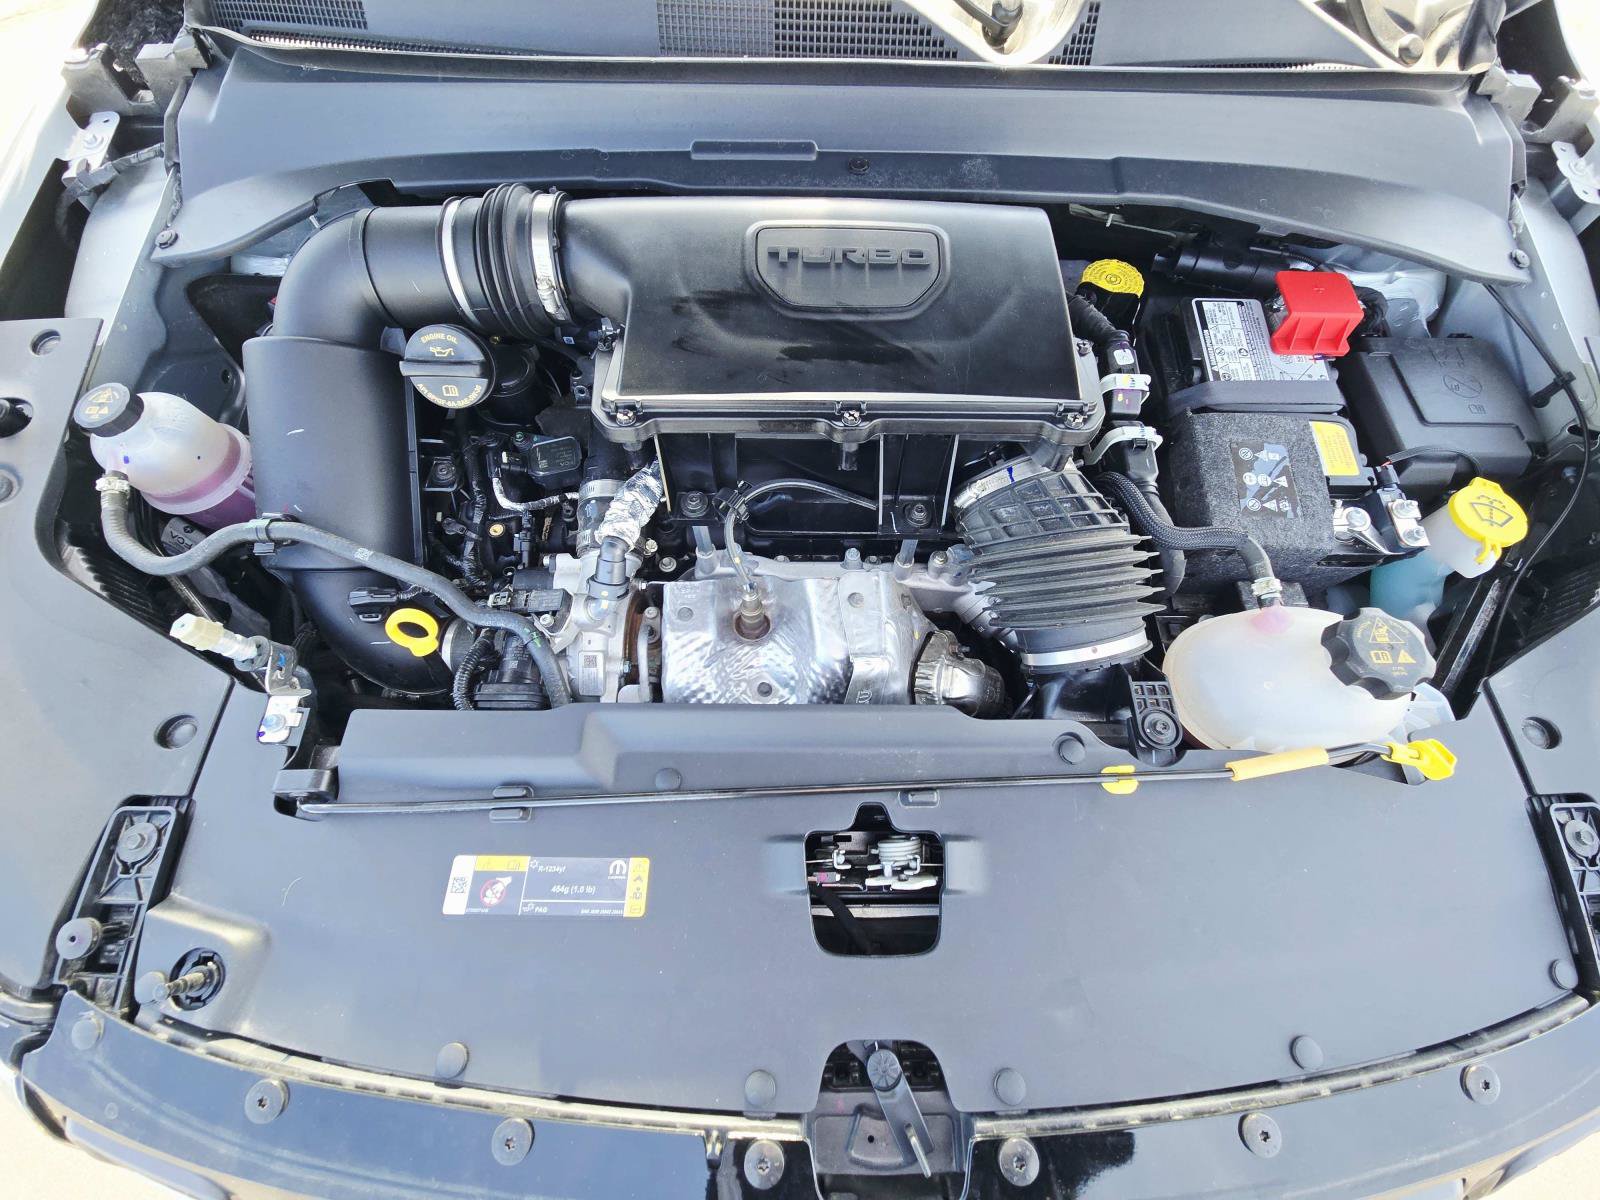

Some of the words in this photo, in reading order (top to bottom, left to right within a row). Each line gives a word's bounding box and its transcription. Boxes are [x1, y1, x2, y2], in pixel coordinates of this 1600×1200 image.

[767, 246, 931, 265] TURBO
[420, 332, 446, 344] ENGINE
[446, 334, 458, 344] OIL
[416, 383, 428, 395] API
[170, 531, 193, 550] FCA
[585, 885, 597, 896] lb)
